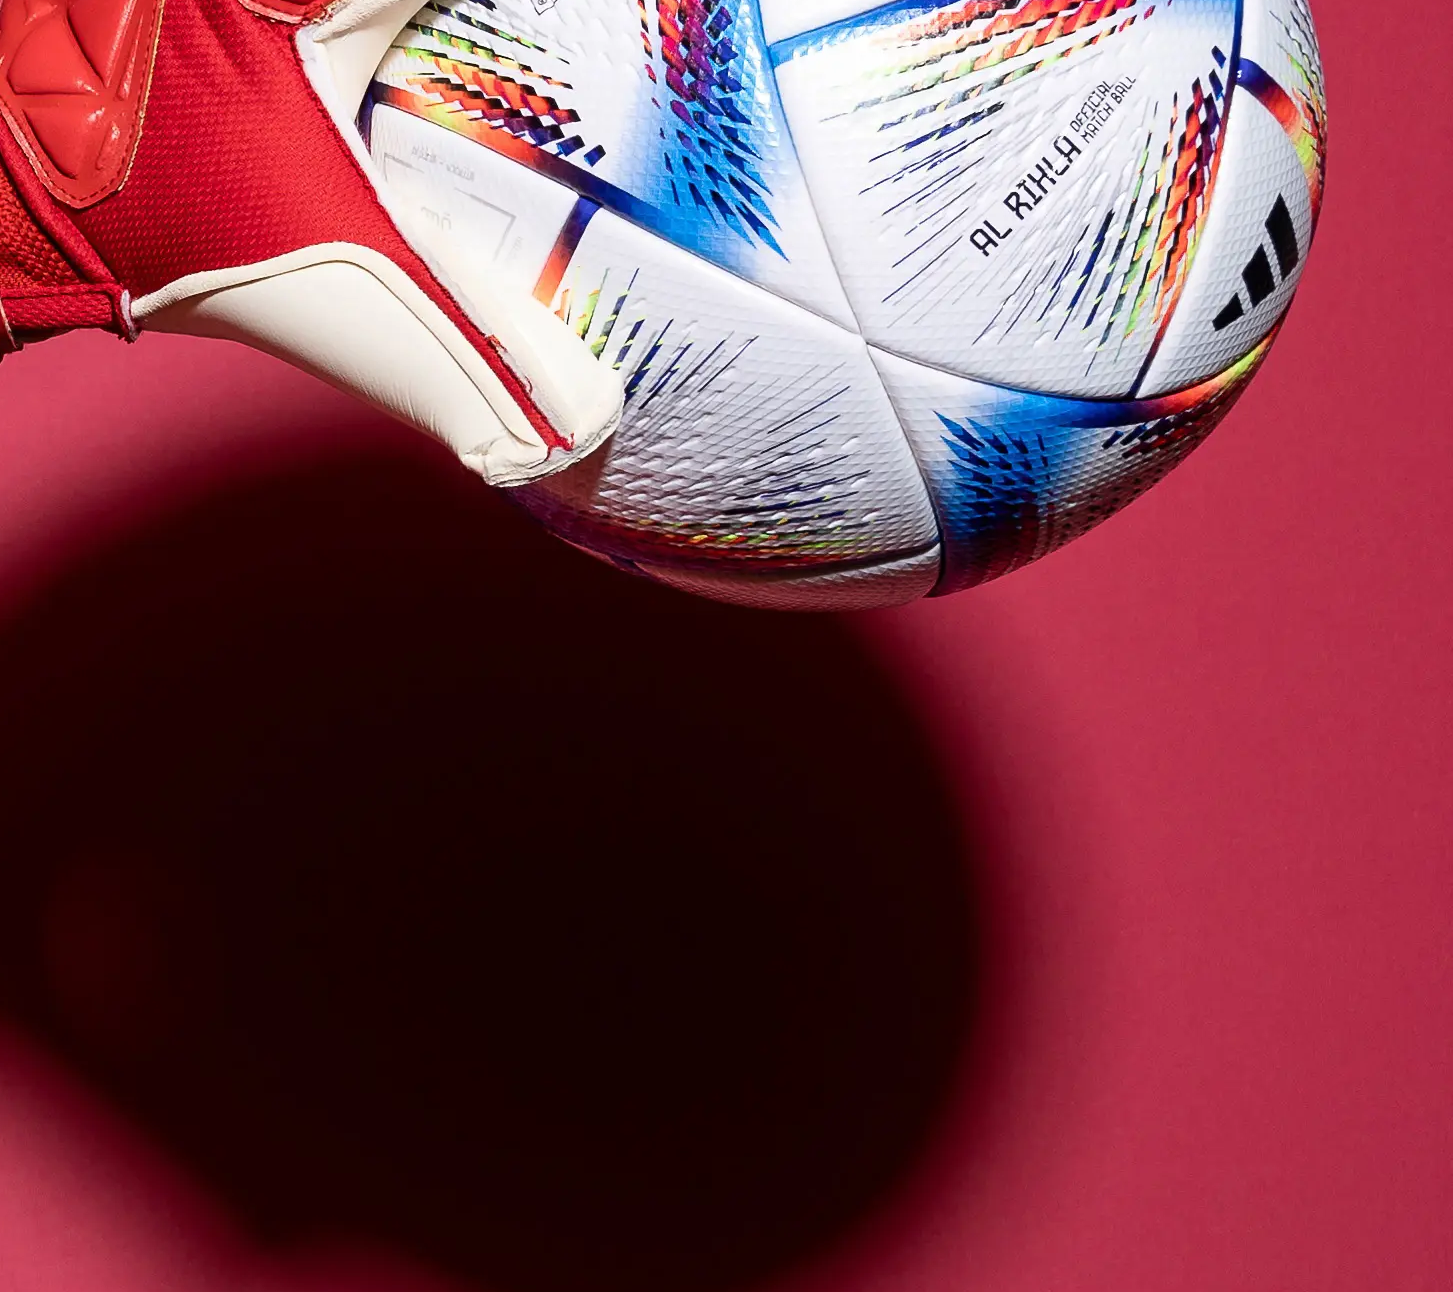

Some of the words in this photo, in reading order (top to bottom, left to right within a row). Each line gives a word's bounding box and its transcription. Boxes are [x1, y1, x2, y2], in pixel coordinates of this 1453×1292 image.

[1070, 80, 1115, 132] OFFICIAL
[1080, 102, 1115, 143] MATCH
[1110, 76, 1136, 104] BALL
[969, 220, 1013, 256] AL
[1003, 135, 1082, 220] RIHLA
